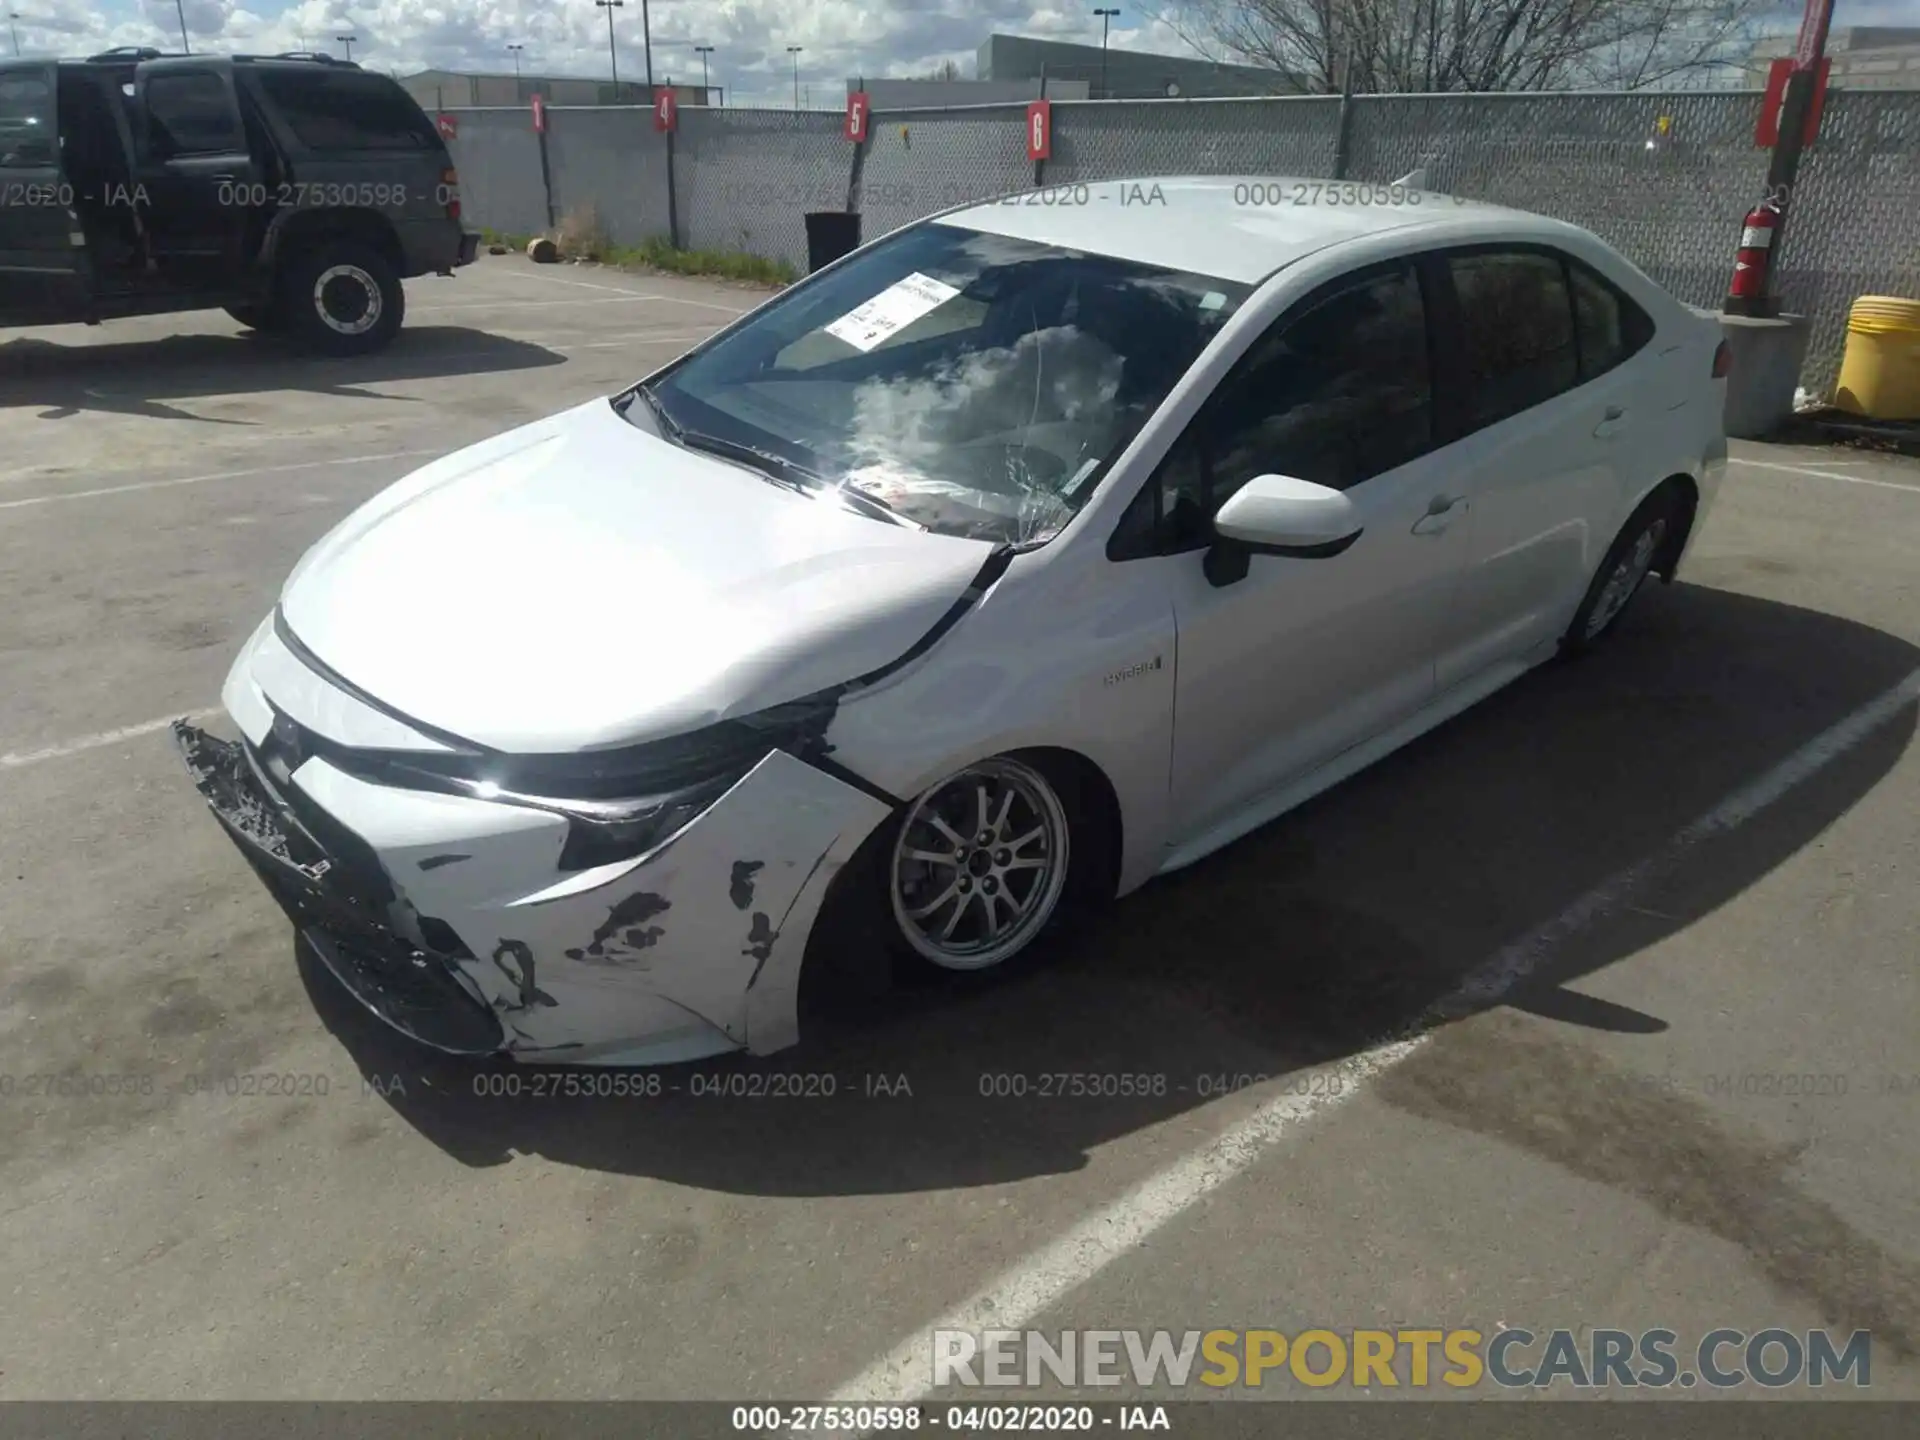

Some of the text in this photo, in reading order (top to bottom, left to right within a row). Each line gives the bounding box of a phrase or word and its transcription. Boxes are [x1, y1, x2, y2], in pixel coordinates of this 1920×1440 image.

[660, 96, 669, 125] 4
[851, 103, 862, 134] 5
[1032, 112, 1042, 151] 6
